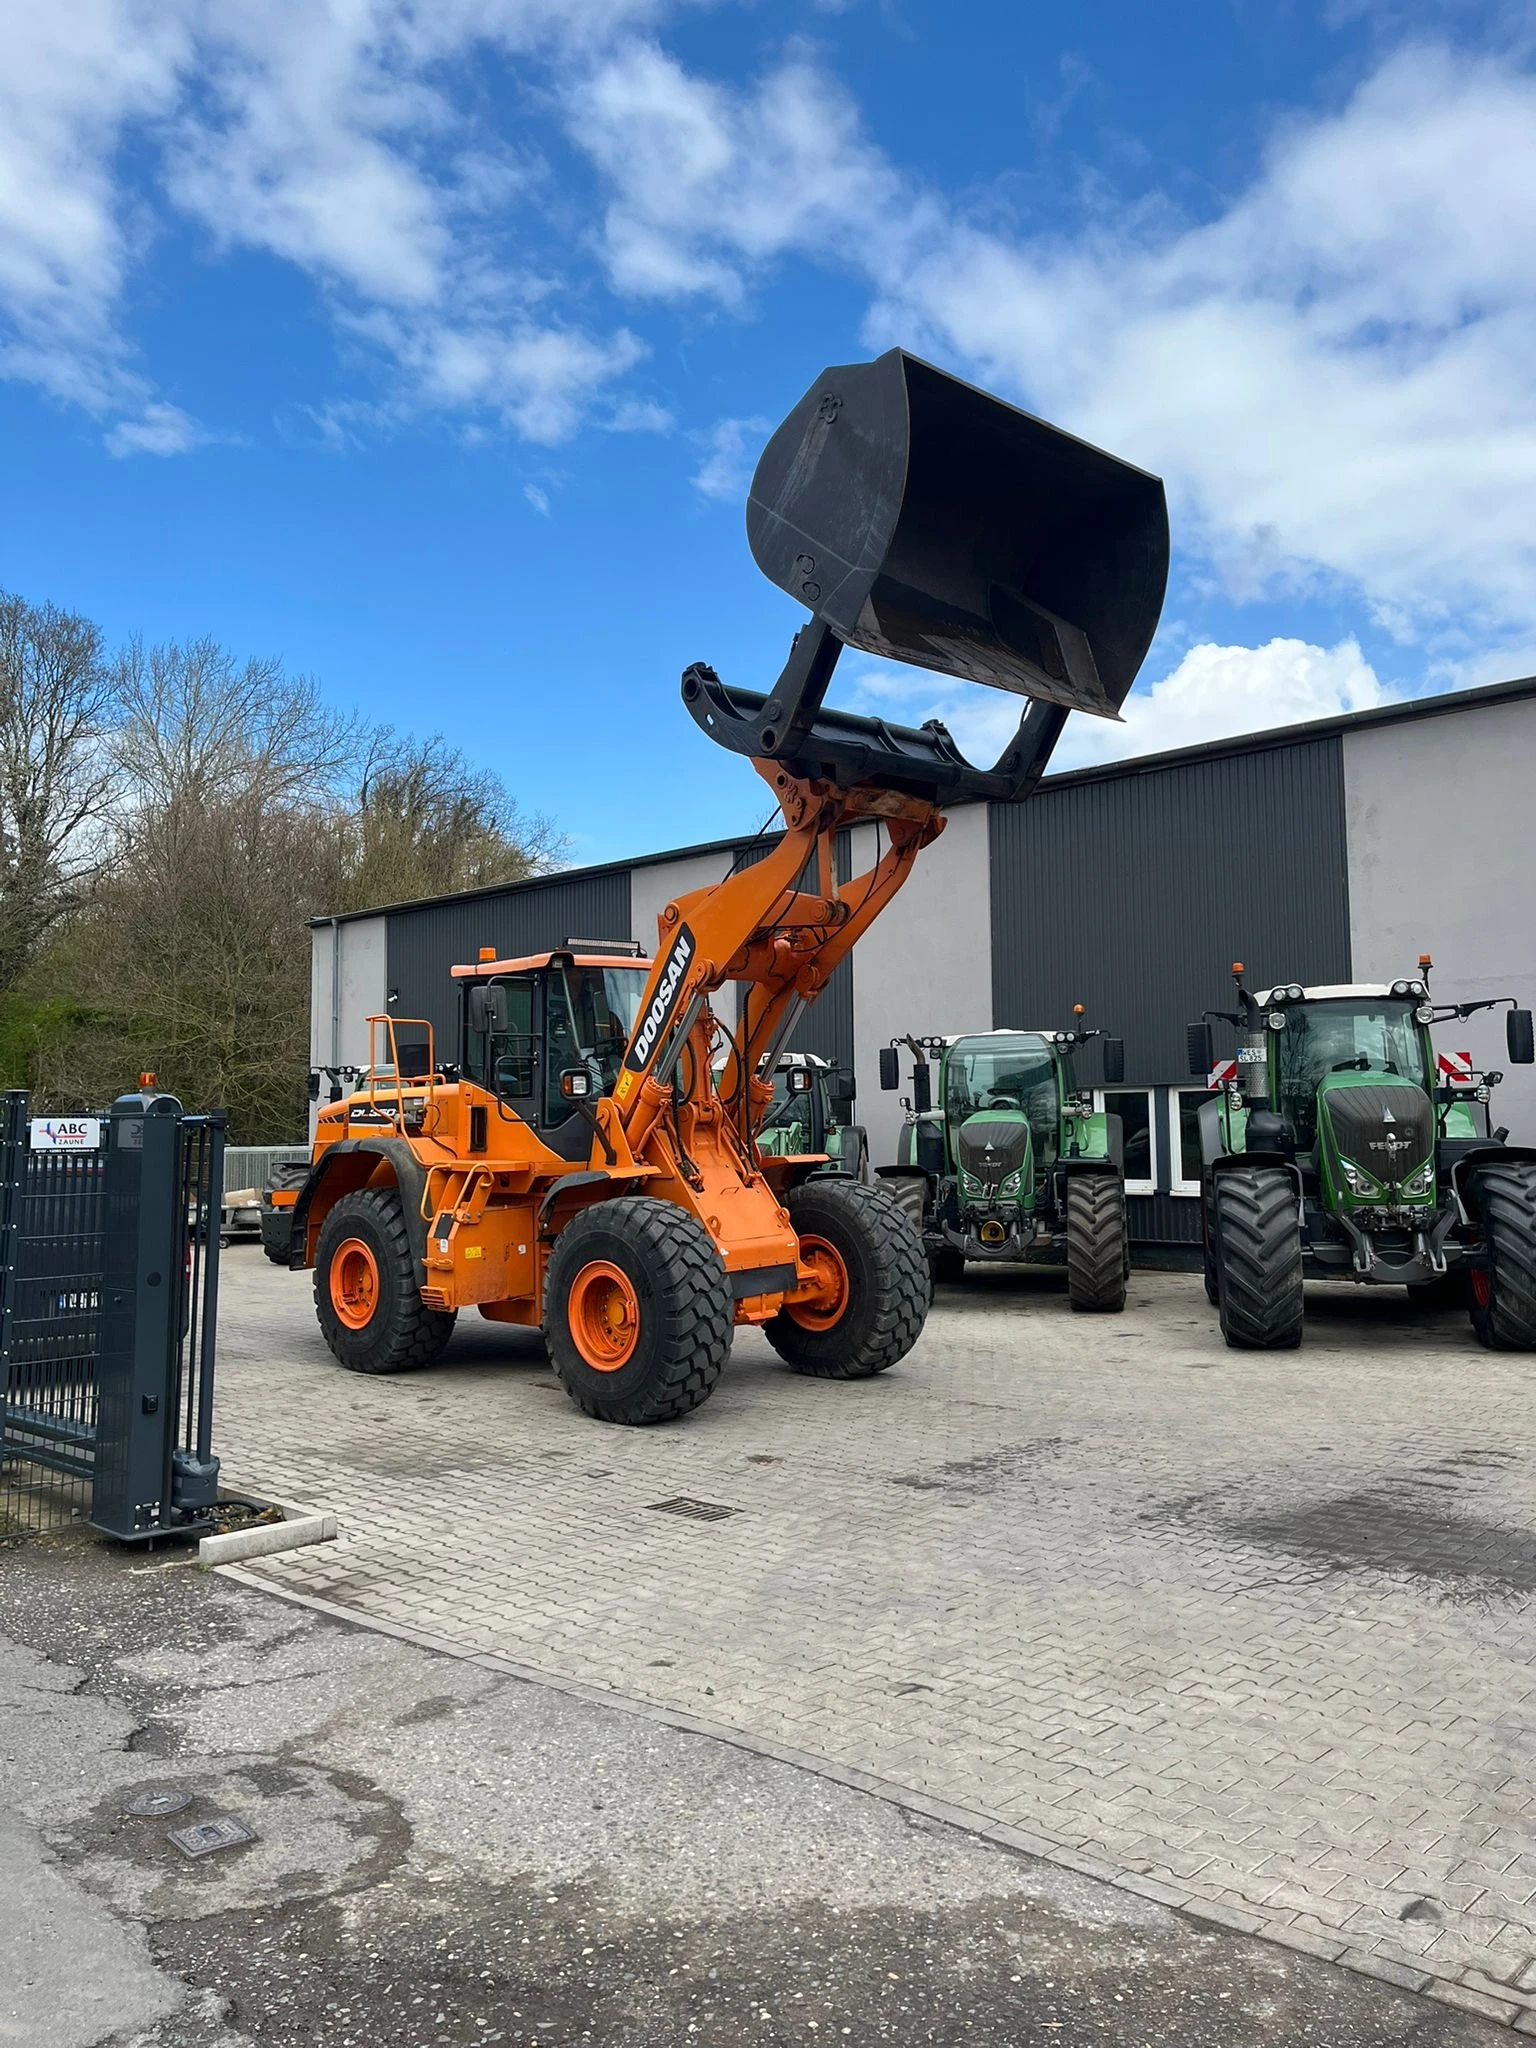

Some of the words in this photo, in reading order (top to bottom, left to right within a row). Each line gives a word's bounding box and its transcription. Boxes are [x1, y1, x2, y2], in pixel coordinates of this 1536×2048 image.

[634, 935, 691, 1065] DOOSAN
[57, 1123, 88, 1134] ABC
[1368, 1141, 1412, 1150] FEDT
